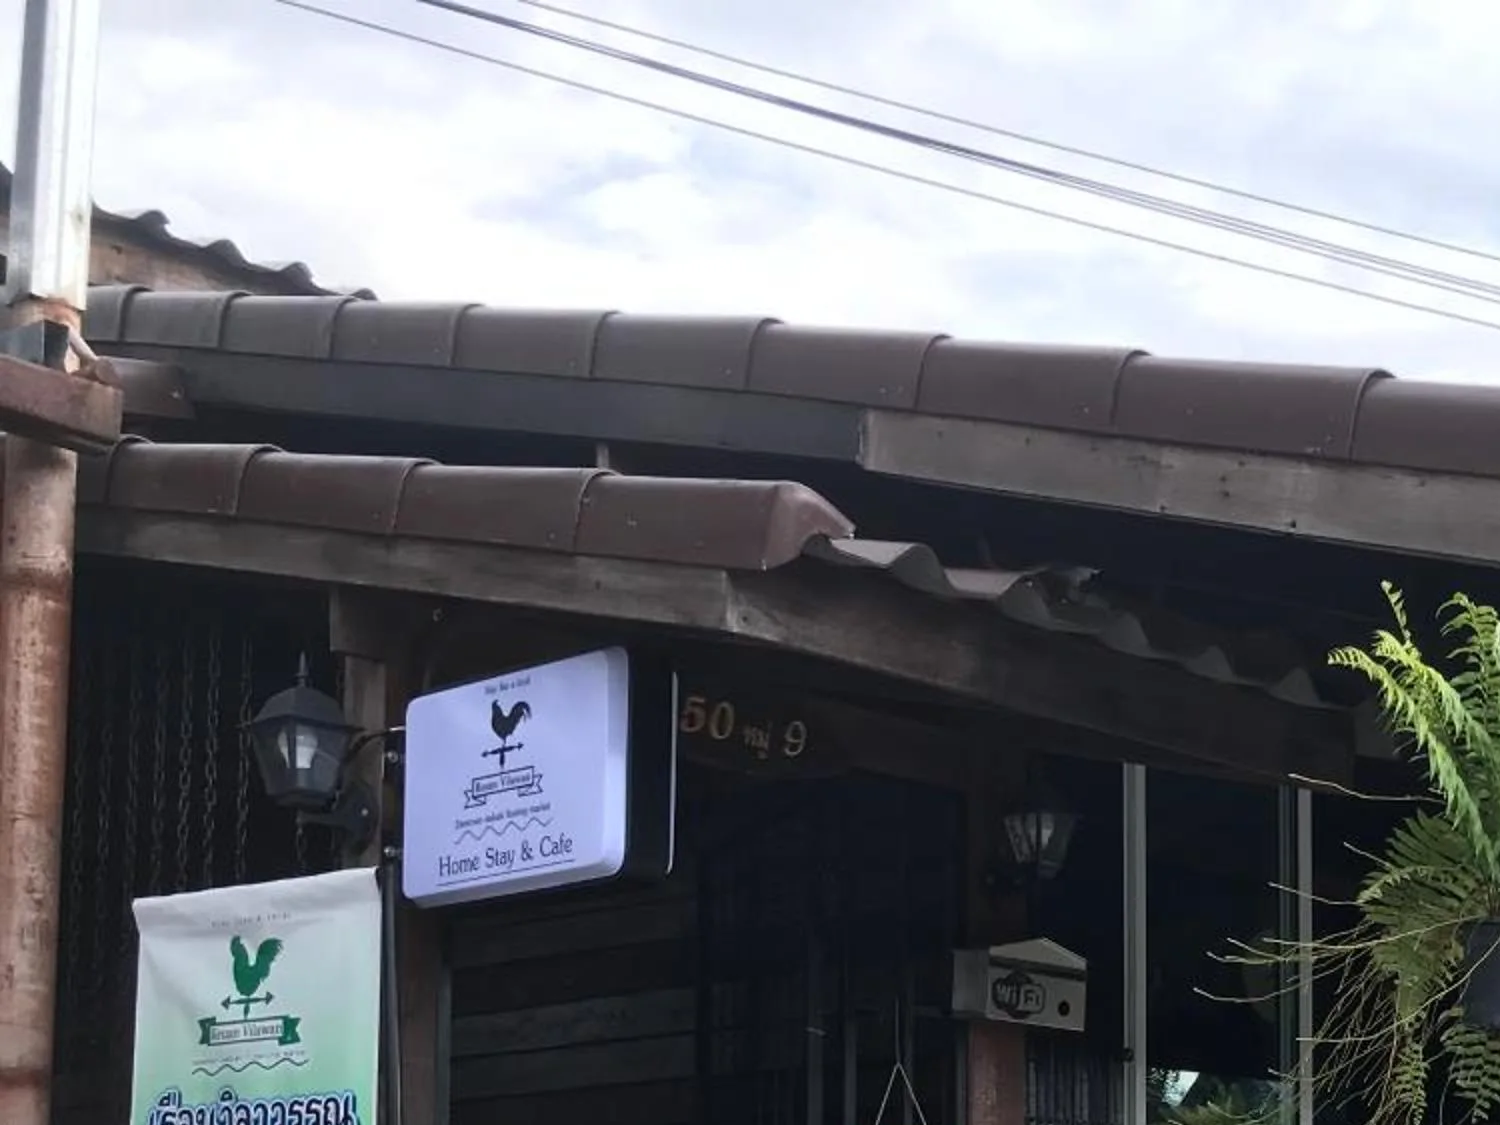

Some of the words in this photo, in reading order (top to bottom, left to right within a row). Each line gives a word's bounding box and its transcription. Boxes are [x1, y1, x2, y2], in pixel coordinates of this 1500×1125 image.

[680, 697, 734, 740] 50
[784, 720, 807, 756] 9
[438, 855, 480, 877] Home
[485, 847, 515, 870] Stay
[520, 839, 534, 862] &
[539, 832, 573, 858] Cafe
